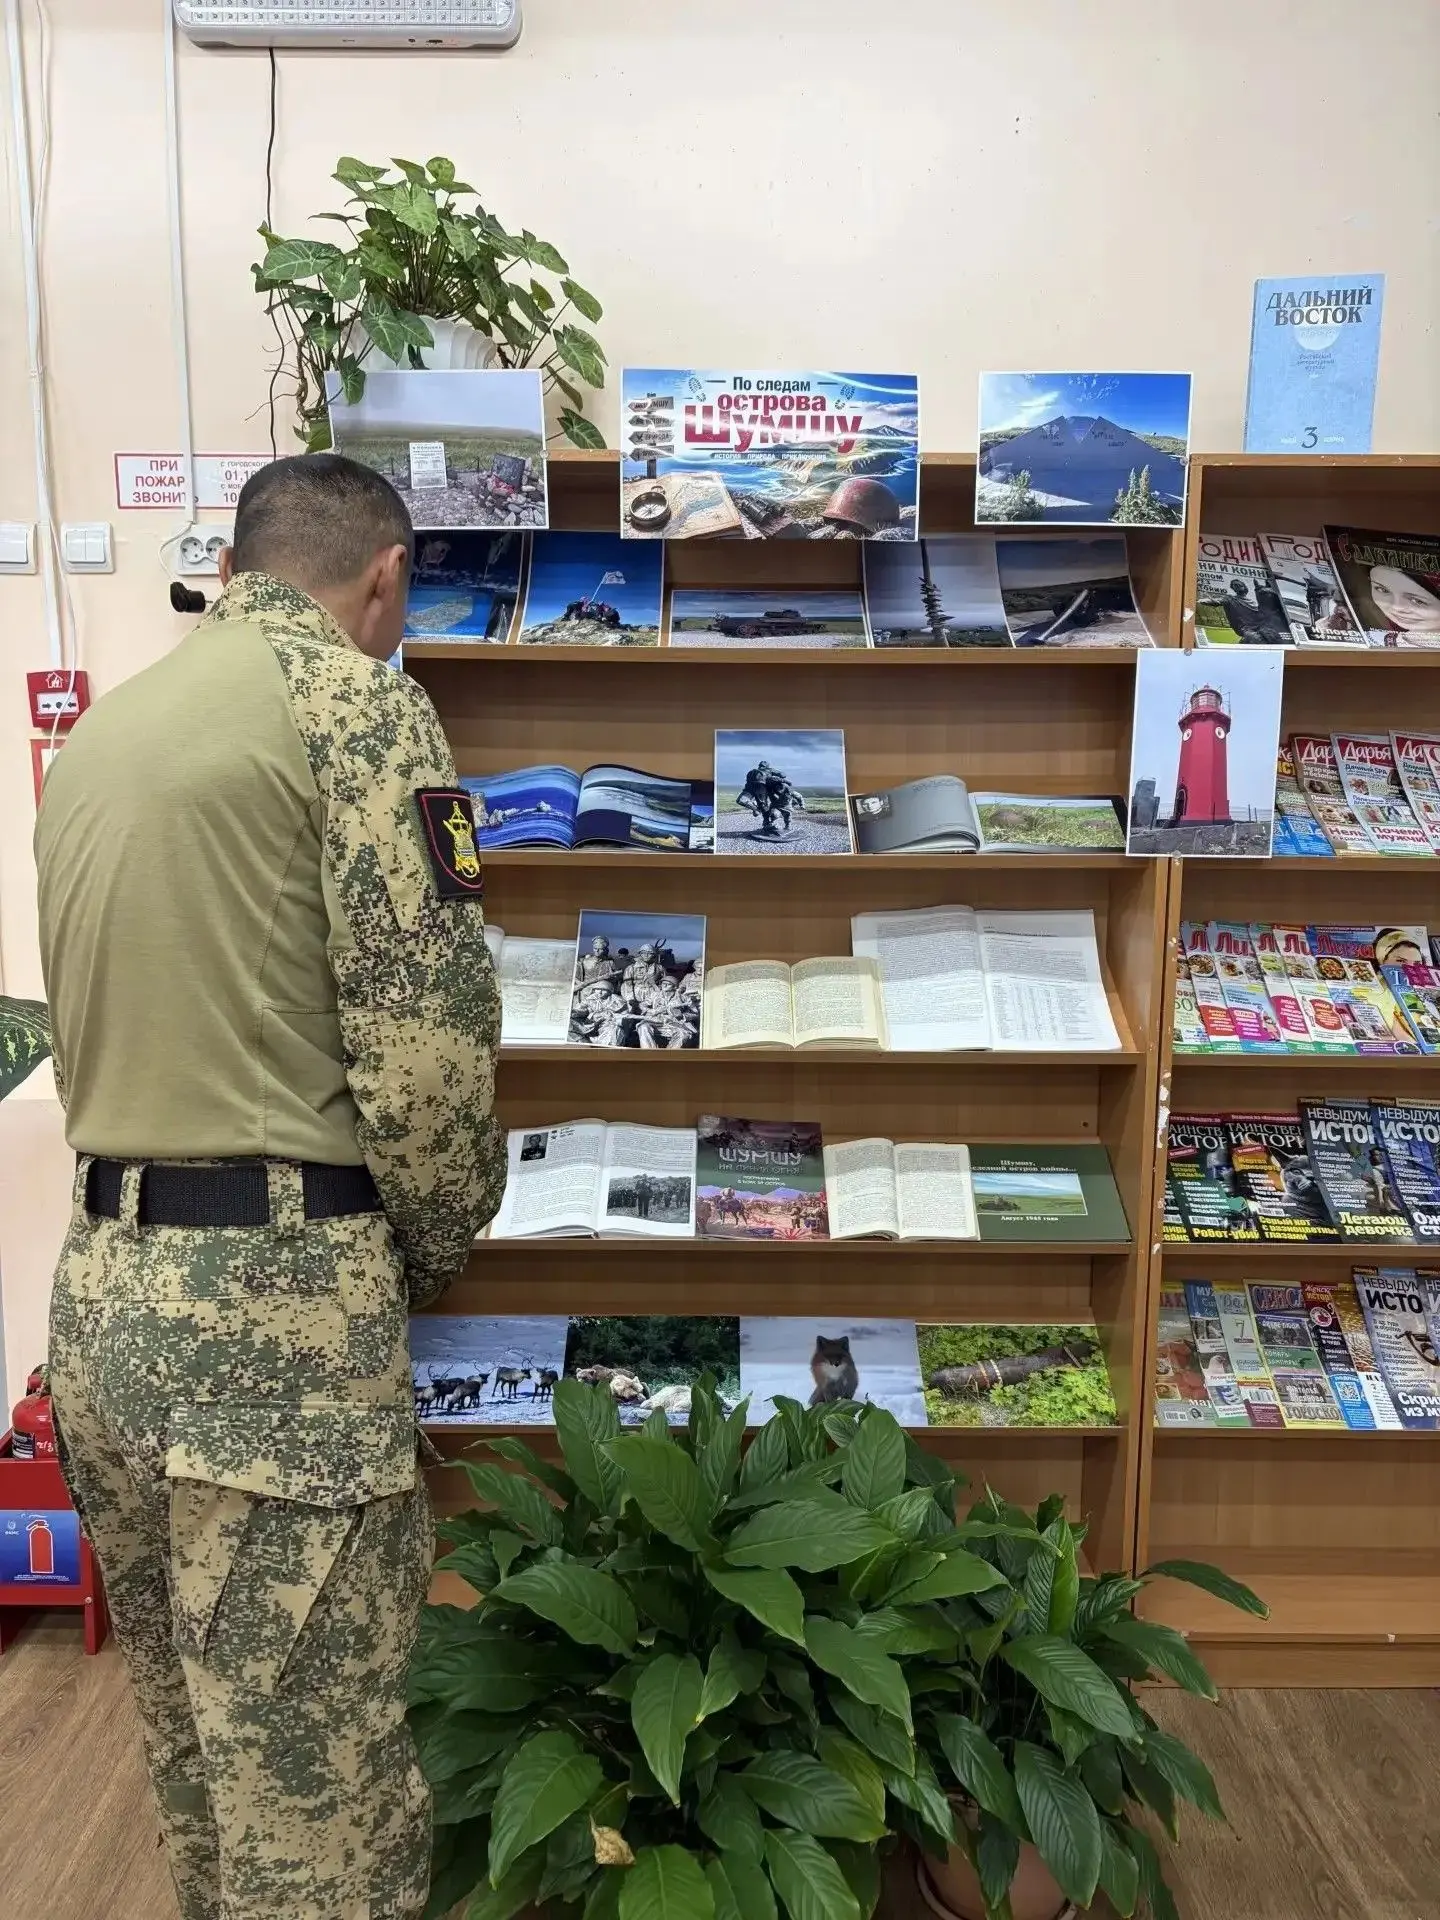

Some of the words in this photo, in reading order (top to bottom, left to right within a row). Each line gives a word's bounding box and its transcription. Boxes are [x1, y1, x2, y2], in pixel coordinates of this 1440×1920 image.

[1266, 285, 1373, 313] ДАЛЬНИЙ
[1274, 307, 1363, 326] ВОСТОК
[733, 377, 752, 391] По
[755, 378, 811, 392] следам
[718, 394, 827, 416] острова
[1301, 426, 1319, 449] 3
[150, 460, 178, 472] ПРИ
[135, 475, 185, 487] ПОЖАР
[1199, 536, 1267, 564] ОДИН
[1302, 740, 1336, 767] Дар
[1343, 741, 1392, 767] Дарья
[1307, 1107, 1372, 1121] НЕВЫДУМ
[1378, 1107, 1440, 1122] НЕВЫДУМ
[1169, 1124, 1224, 1137] АИНСТВ
[1226, 1122, 1302, 1136] ТАИНСТВЕ
[1380, 1120, 1440, 1144] ИСТО
[719, 1147, 804, 1166] ШУМШУ
[1362, 1277, 1419, 1292] НЕВЫДУМ
[1366, 1289, 1424, 1314] ИСТО
